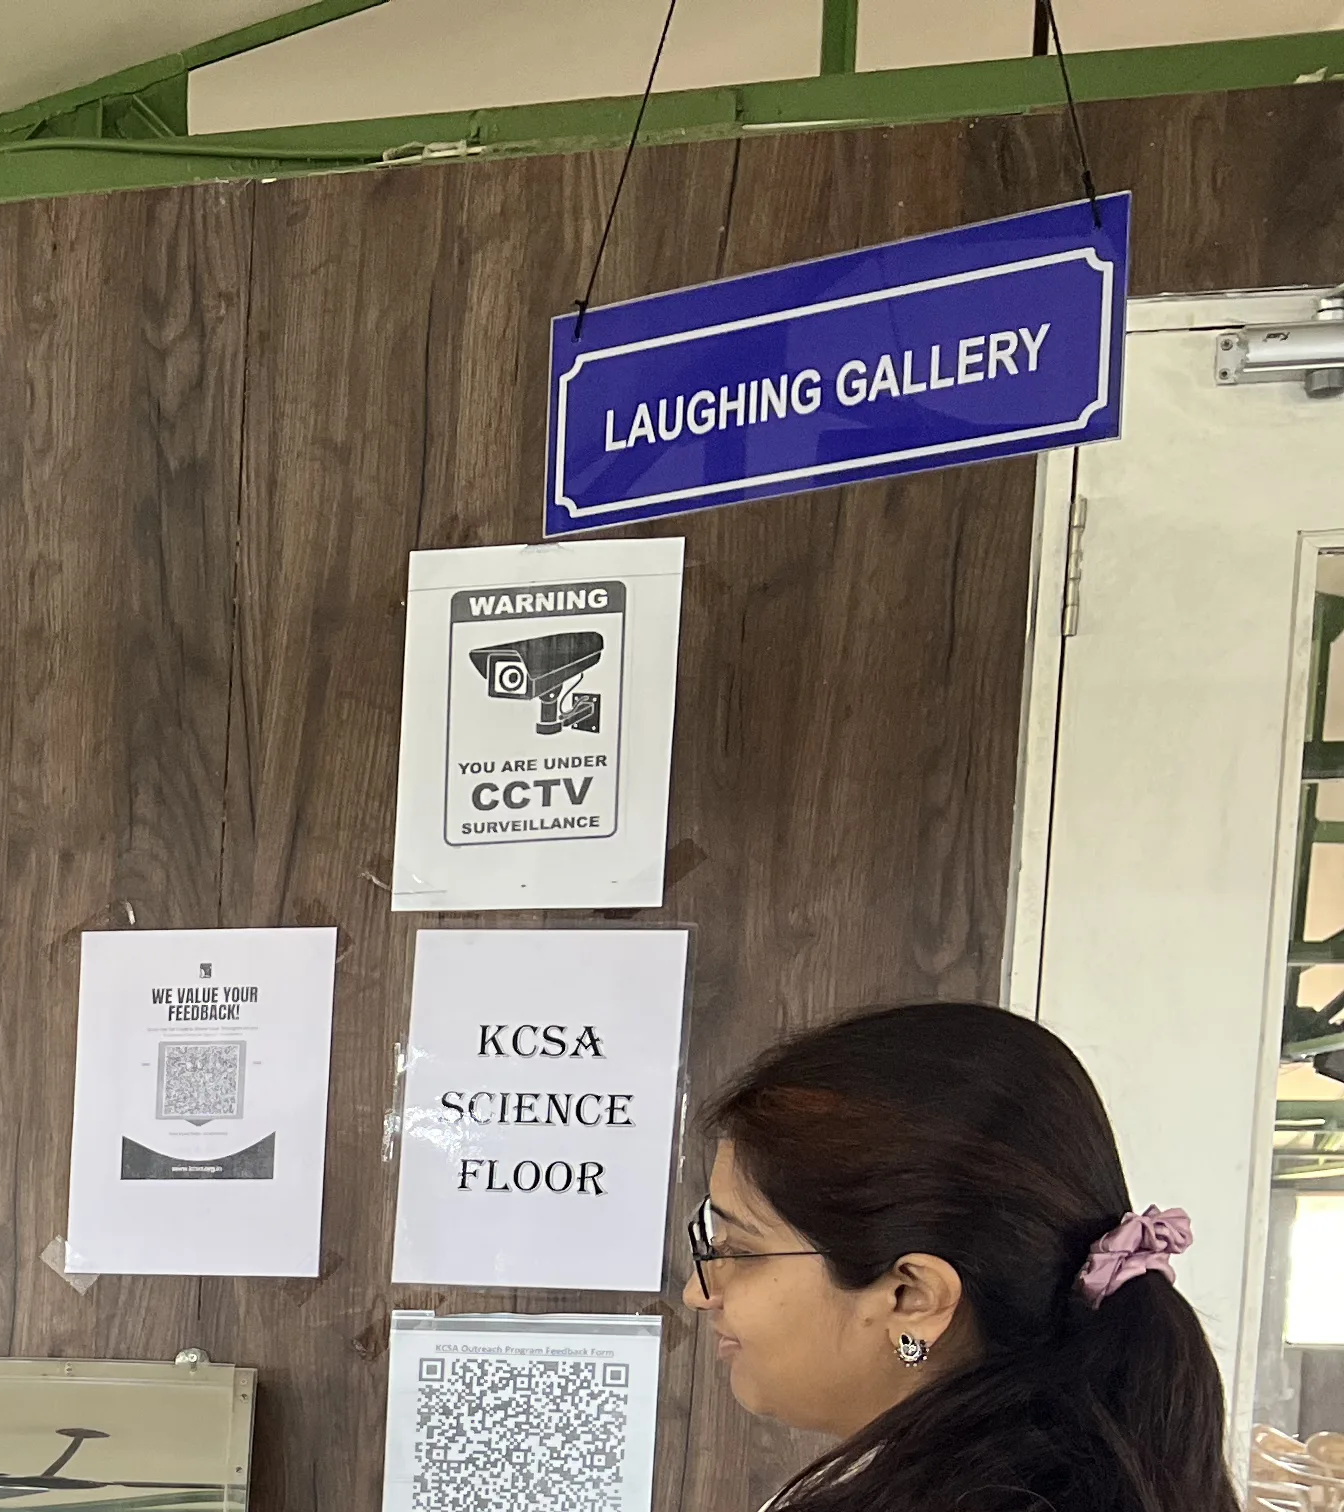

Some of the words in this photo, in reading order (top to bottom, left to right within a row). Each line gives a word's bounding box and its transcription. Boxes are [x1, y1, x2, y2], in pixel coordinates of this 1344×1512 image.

[604, 368, 822, 453] LAUGHING
[835, 323, 1052, 408] GALLERY
[469, 588, 609, 616] WARNING
[458, 760, 496, 775] YOU
[501, 758, 538, 773] ARE
[544, 754, 608, 770] UNDER
[471, 776, 594, 812] CCTV
[461, 815, 601, 836] SURVEILLANCE
[152, 987, 172, 1004] WE
[177, 987, 219, 1004] VALUE
[223, 986, 258, 1003] YOUR
[168, 1003, 240, 1021] FEEDBACK!
[478, 1024, 607, 1059] KCSA
[440, 1091, 636, 1128] SCIENCE
[457, 1158, 609, 1196] FLOOR
[435, 1344, 458, 1353] KCSA
[461, 1344, 503, 1354] Outreach
[505, 1345, 543, 1356] Program
[545, 1346, 588, 1356] Feedback
[591, 1348, 614, 1358] Form
